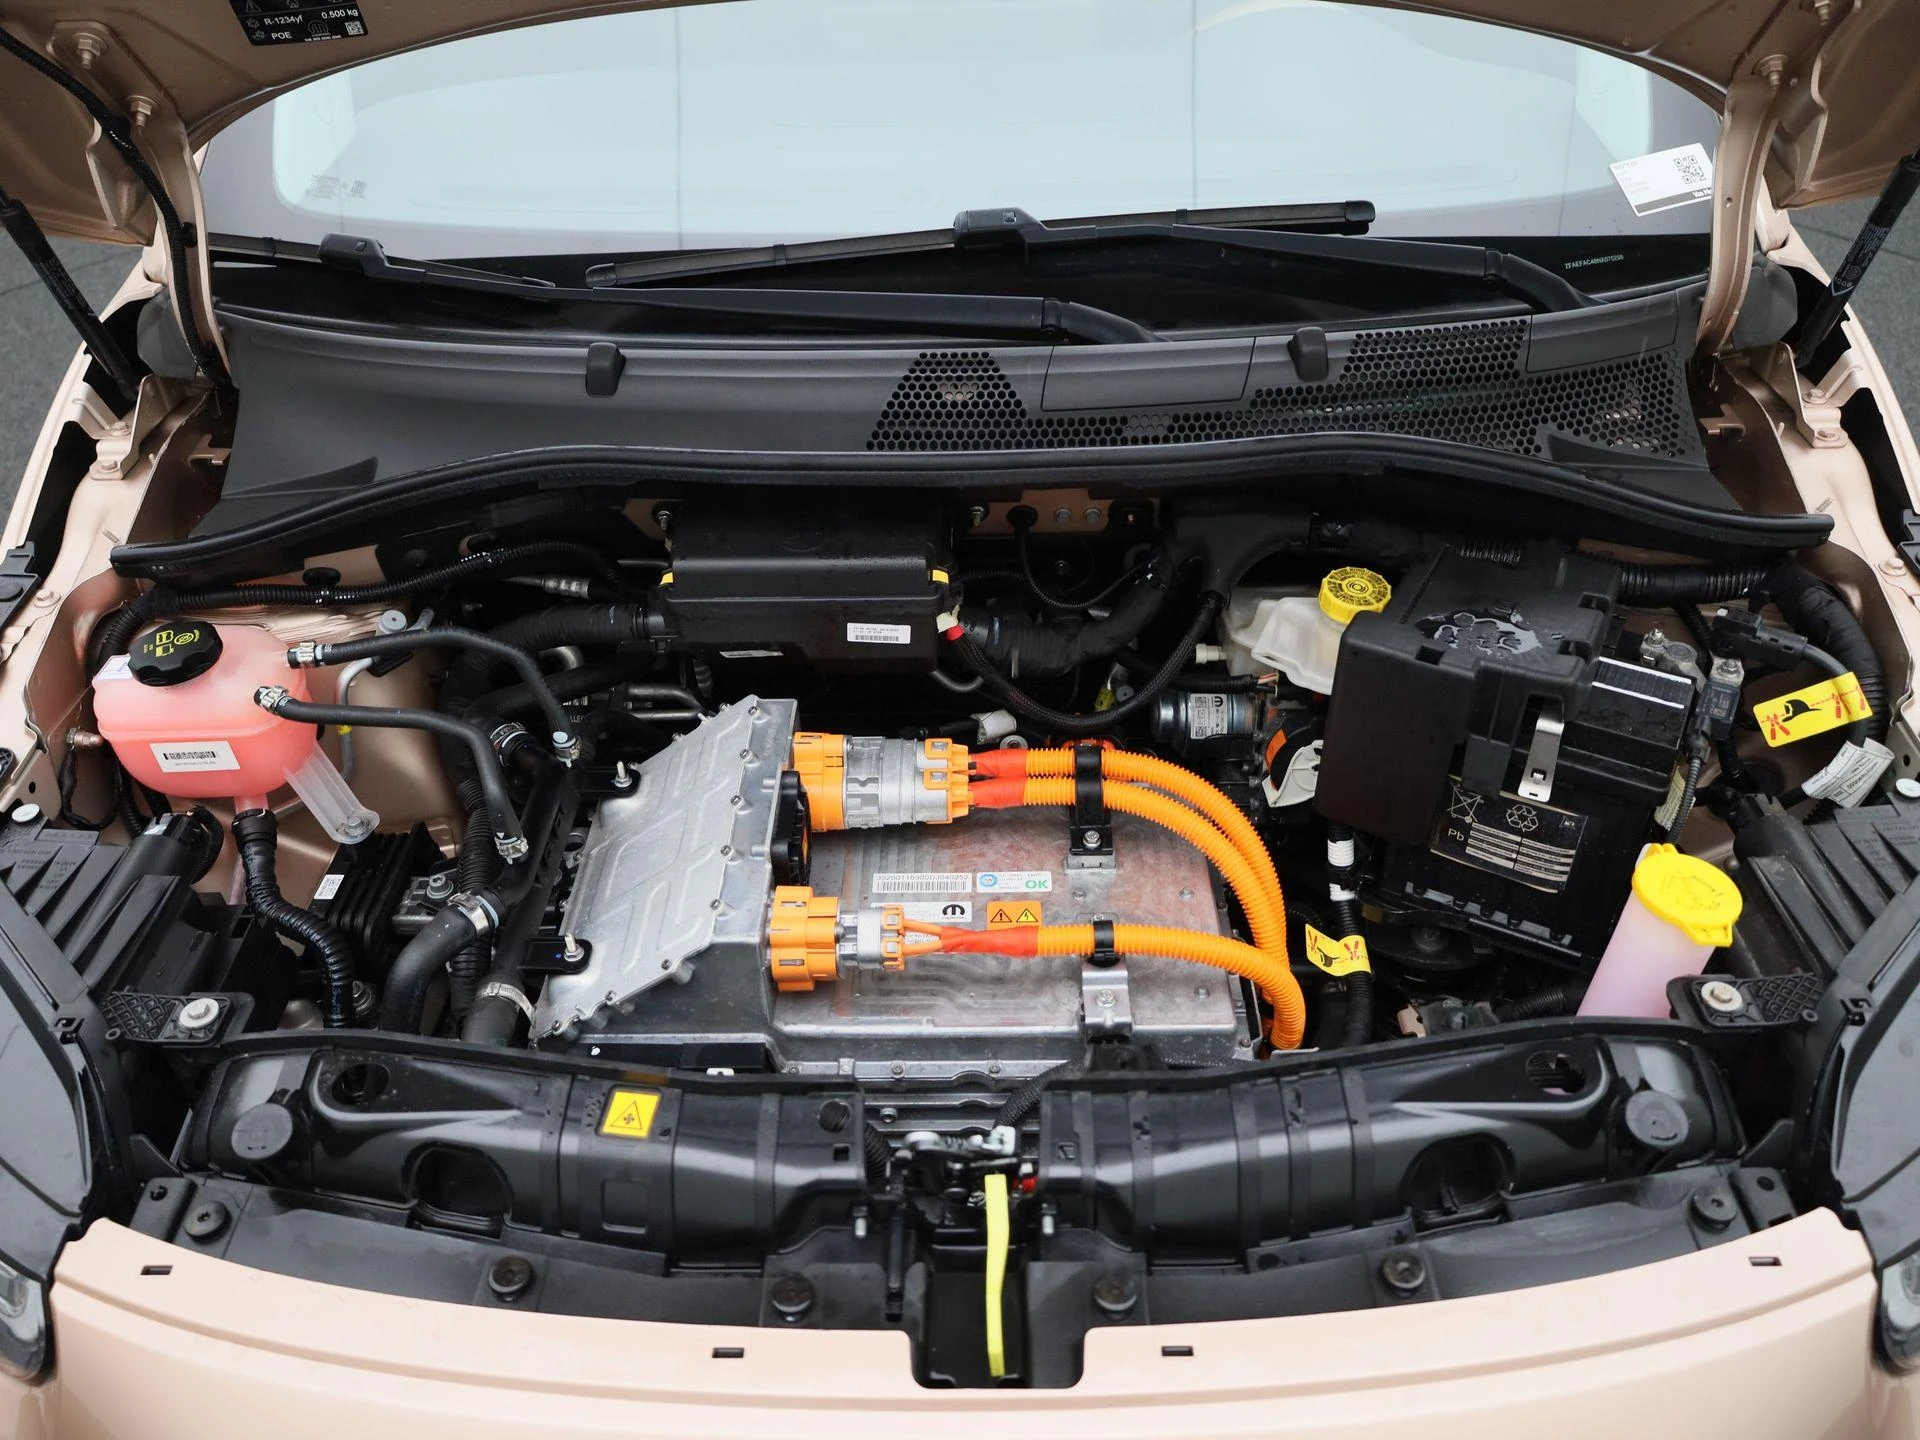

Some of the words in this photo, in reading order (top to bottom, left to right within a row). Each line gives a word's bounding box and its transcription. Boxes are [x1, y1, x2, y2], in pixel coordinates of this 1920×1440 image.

[263, 15, 303, 26] R-1234yf
[321, 9, 346, 19] 0.500
[347, 8, 359, 17] kg
[271, 31, 293, 40] POE
[1447, 828, 1465, 842] Pb
[1025, 879, 1048, 889] OK
